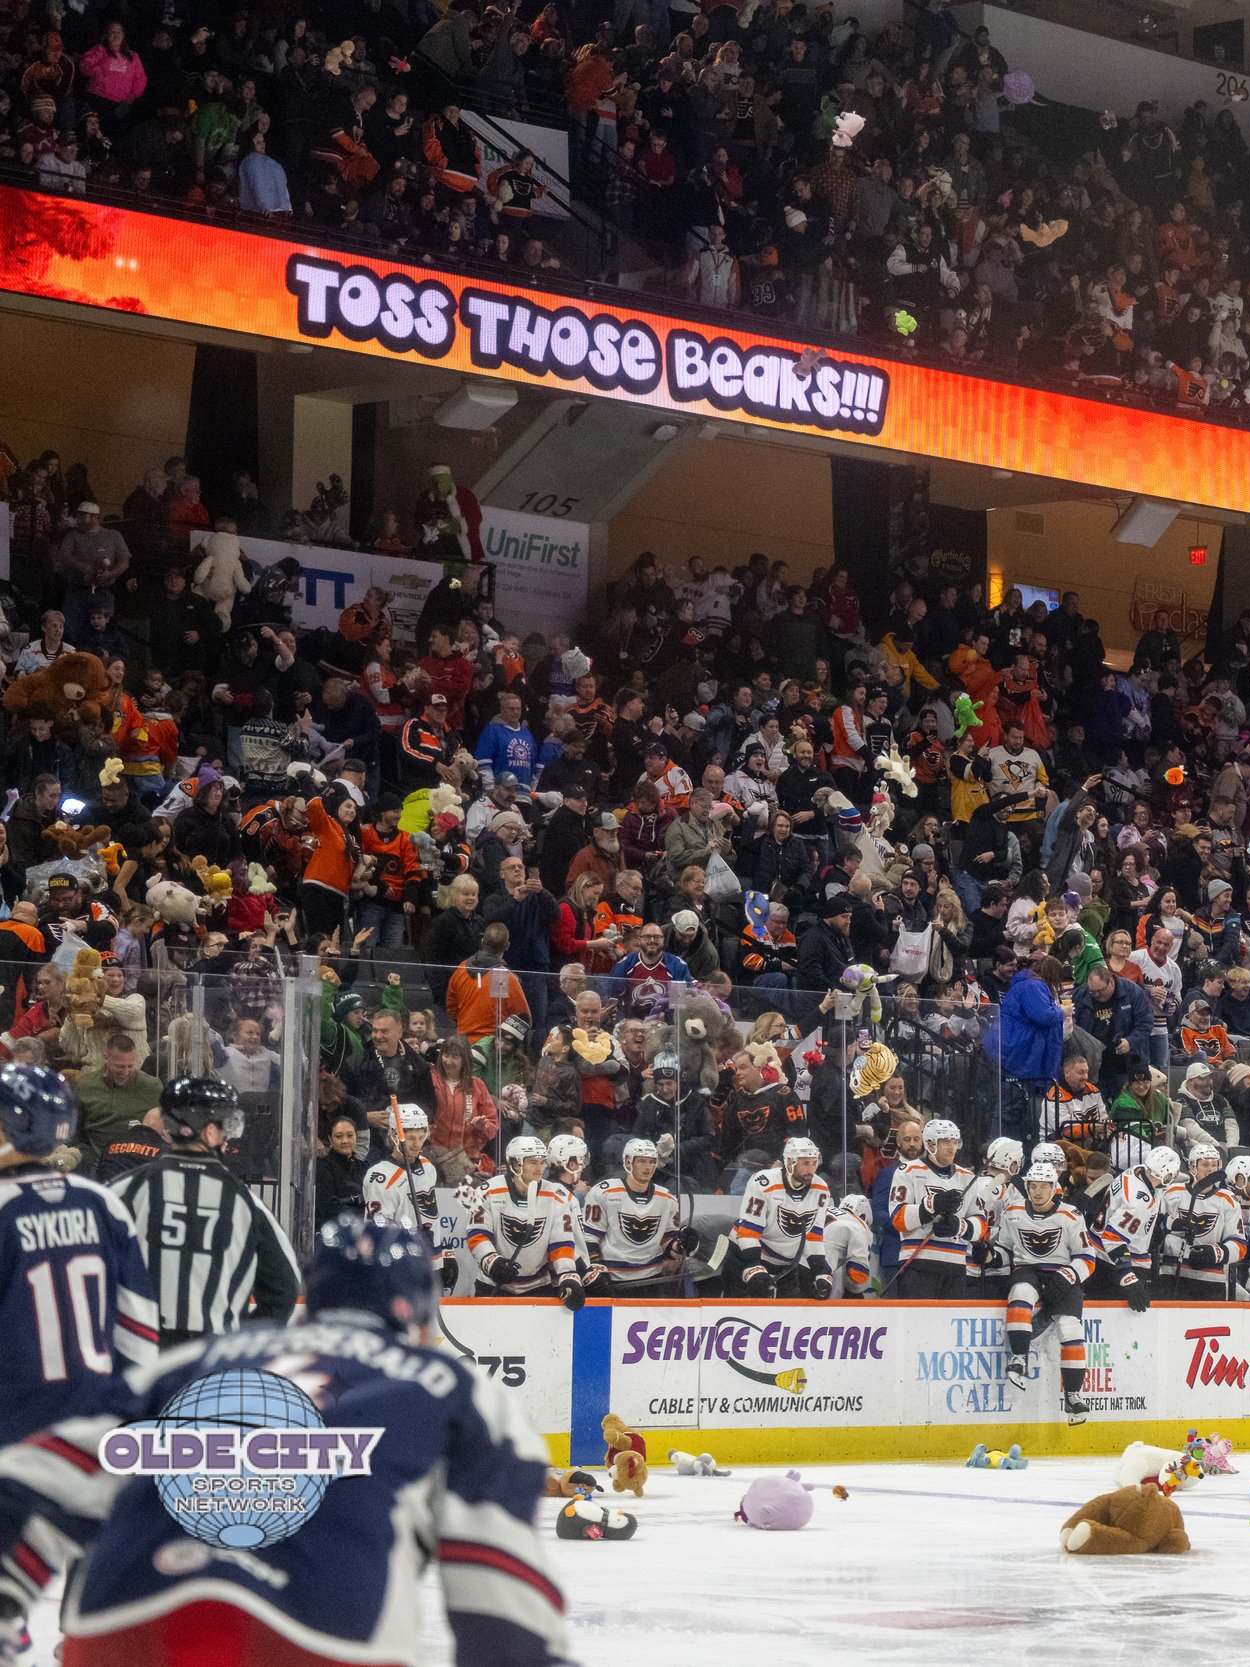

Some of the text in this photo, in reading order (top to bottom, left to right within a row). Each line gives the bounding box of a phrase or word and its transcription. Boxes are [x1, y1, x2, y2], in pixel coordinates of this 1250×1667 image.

[296, 263, 450, 345] TOSS
[519, 492, 580, 516] 105
[486, 527, 581, 568] UniFirst
[786, 1105, 803, 1121] 64
[109, 1142, 160, 1158] SECURITY
[745, 1197, 765, 1217] 17
[817, 1193, 826, 1208] C
[890, 1186, 908, 1202] 13
[15, 1209, 99, 1252] SYKORA
[161, 1202, 220, 1250] 57
[1118, 1211, 1142, 1236] 76
[27, 1254, 113, 1381] 10
[622, 1320, 888, 1365] SERVICE ELECTRIC
[950, 1318, 1005, 1348] THE
[1184, 1326, 1247, 1390] Tim
[649, 1395, 863, 1415] CABLE TV & COMMUNICATIONS
[946, 1383, 1013, 1414] CALL
[1109, 1397, 1124, 1411] HAT
